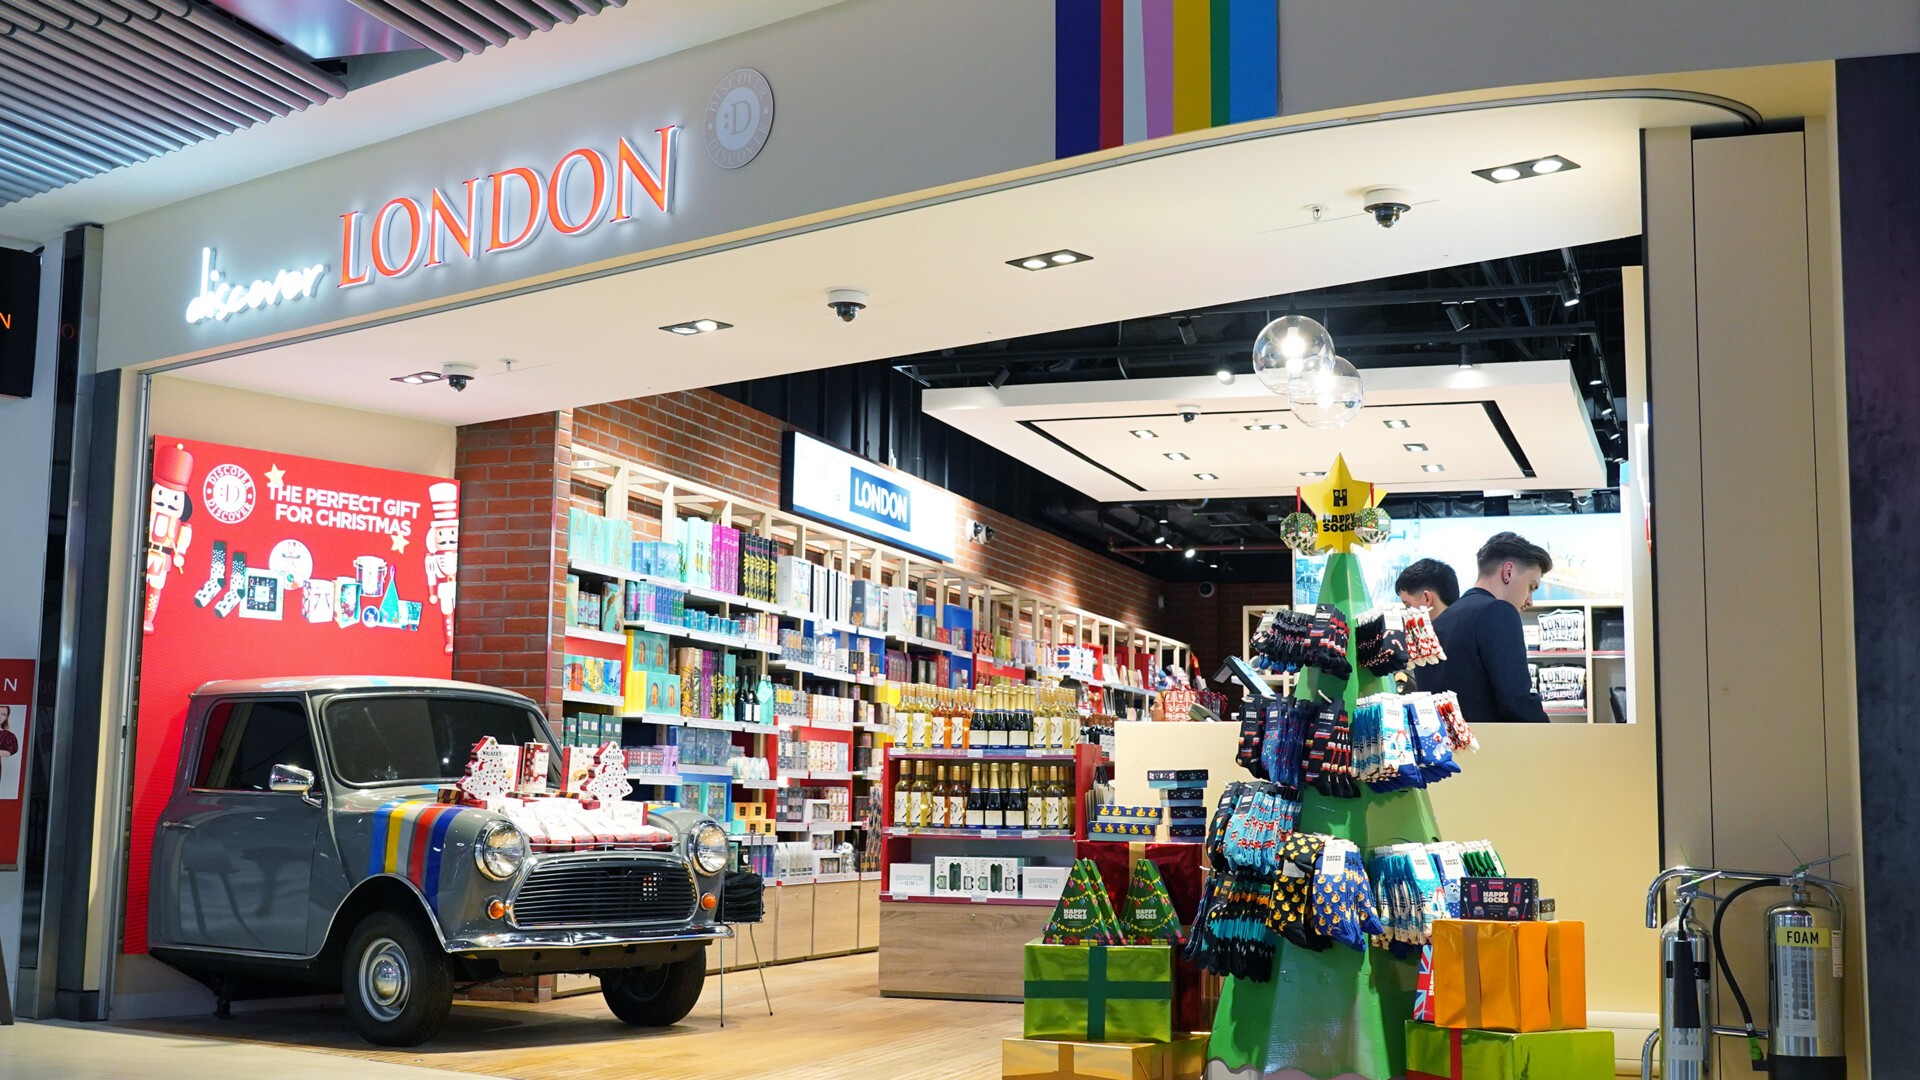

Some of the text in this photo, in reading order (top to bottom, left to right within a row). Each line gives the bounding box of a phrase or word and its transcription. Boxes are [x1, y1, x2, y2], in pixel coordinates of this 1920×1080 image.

[186, 124, 682, 324] discover LONDON
[209, 465, 253, 491] DISCOVER
[207, 499, 253, 522] DISCOVER
[267, 482, 421, 519] THE PERFECT GIFT
[855, 477, 908, 523] LONDON
[275, 503, 412, 537] FOR CHRISTMAS
[1323, 512, 1356, 524] HAPPY
[1323, 522, 1356, 533] SOCKS
[1541, 617, 1579, 632] LONDON
[1541, 669, 1580, 684] LONDON
[1786, 930, 1819, 944] FOAM
